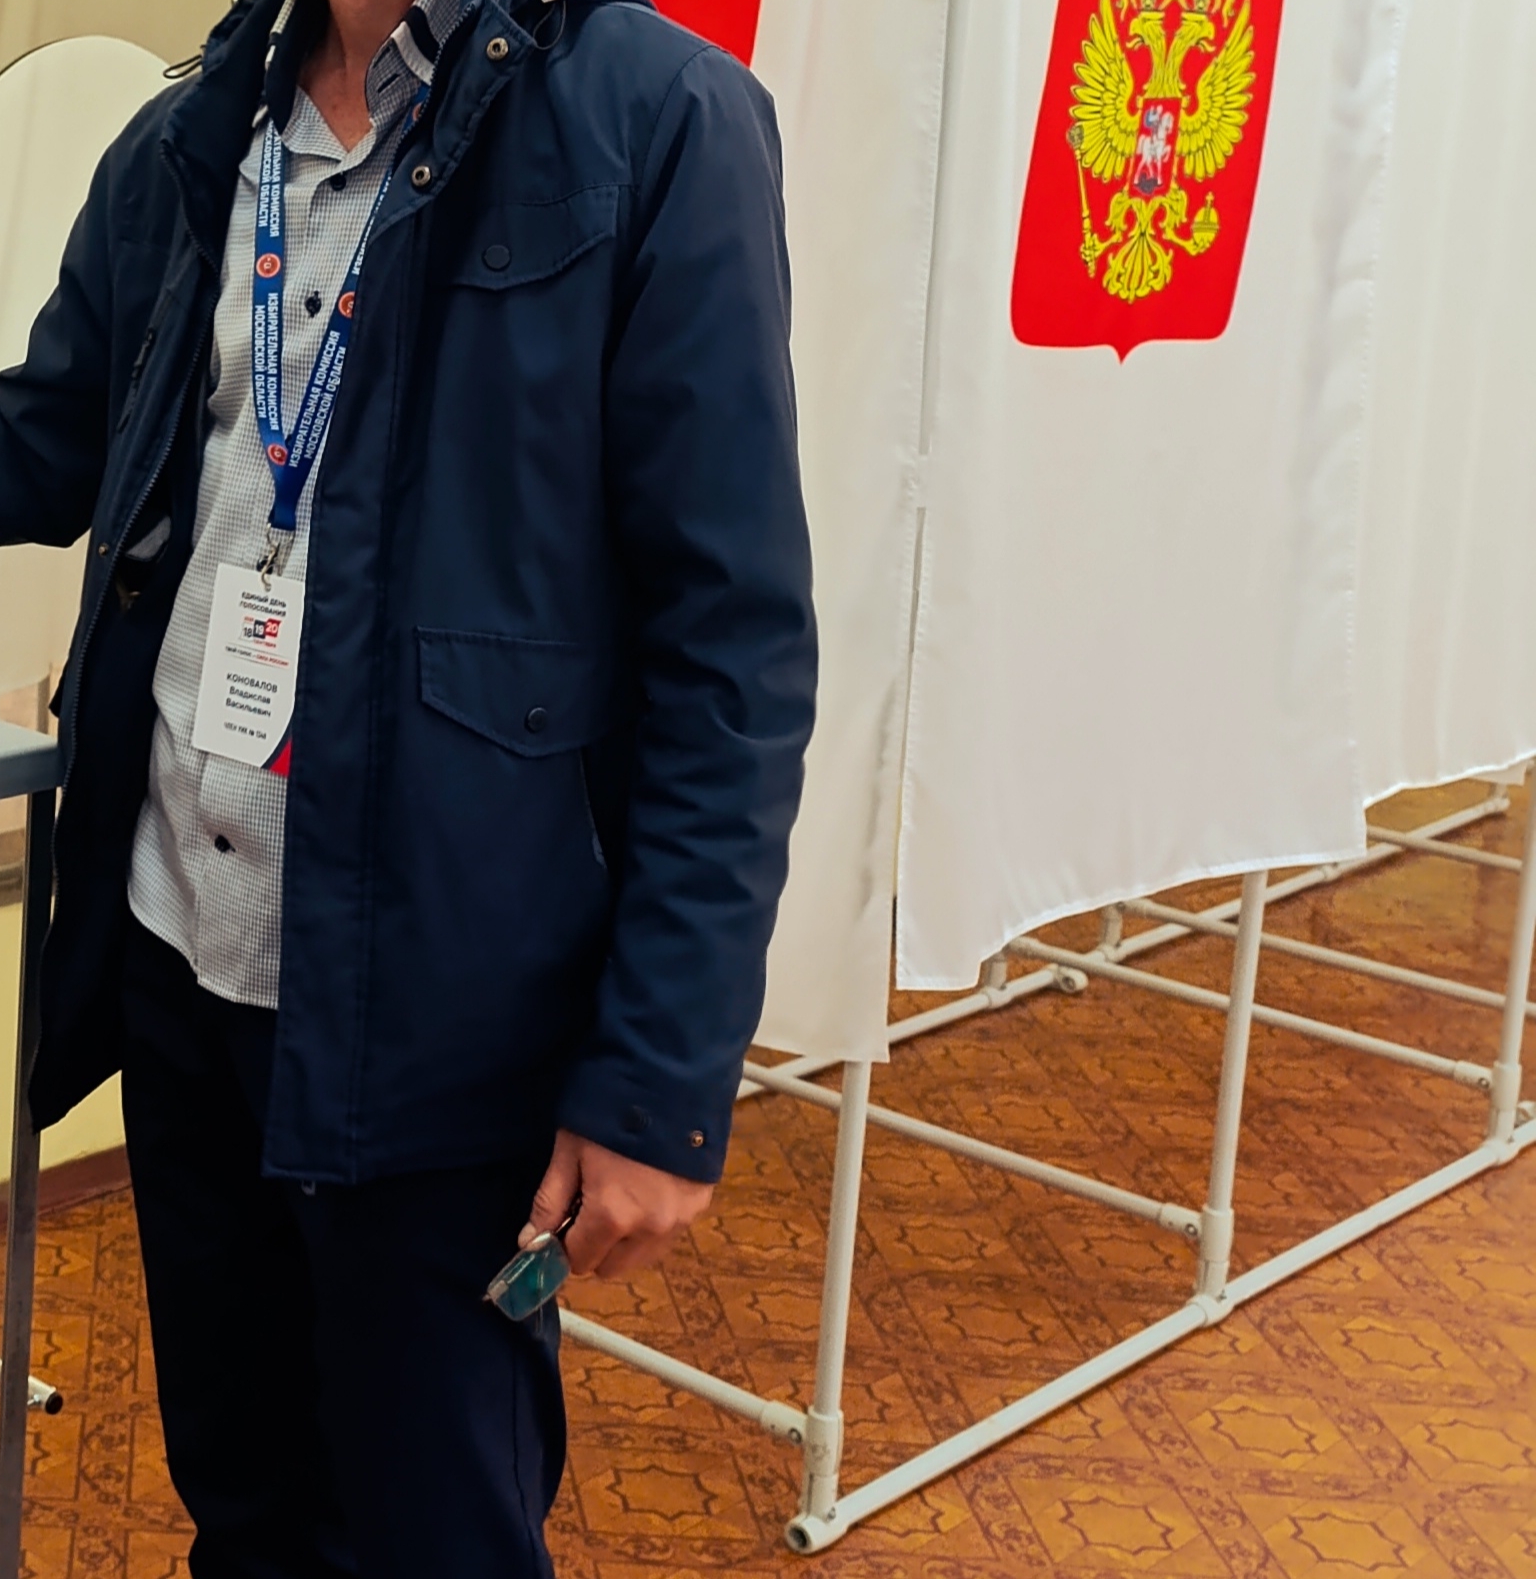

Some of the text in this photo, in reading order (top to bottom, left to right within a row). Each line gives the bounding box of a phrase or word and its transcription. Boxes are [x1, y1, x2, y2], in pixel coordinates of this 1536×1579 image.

[258, 184, 269, 228] ОБЛАСТИ
[269, 183, 280, 238] КОМИССИЯ
[254, 305, 267, 419] МОСКОВСКОЙ ОБЛАСТИ
[267, 292, 279, 431] ИЗБИРАТЕЛЬНАЯ КОМИССИЯ
[288, 330, 341, 468] ИЗБИРАТЕЛЬНАЯ КОМИССИЯ
[304, 346, 346, 460] МОСКОВСКОЙ ОБЛАСТИ
[244, 621, 278, 638] 18 19 20
[226, 672, 278, 693] КОНОВАЛОВ
[226, 697, 271, 717] Васильевич
[229, 685, 271, 704] Владислав
